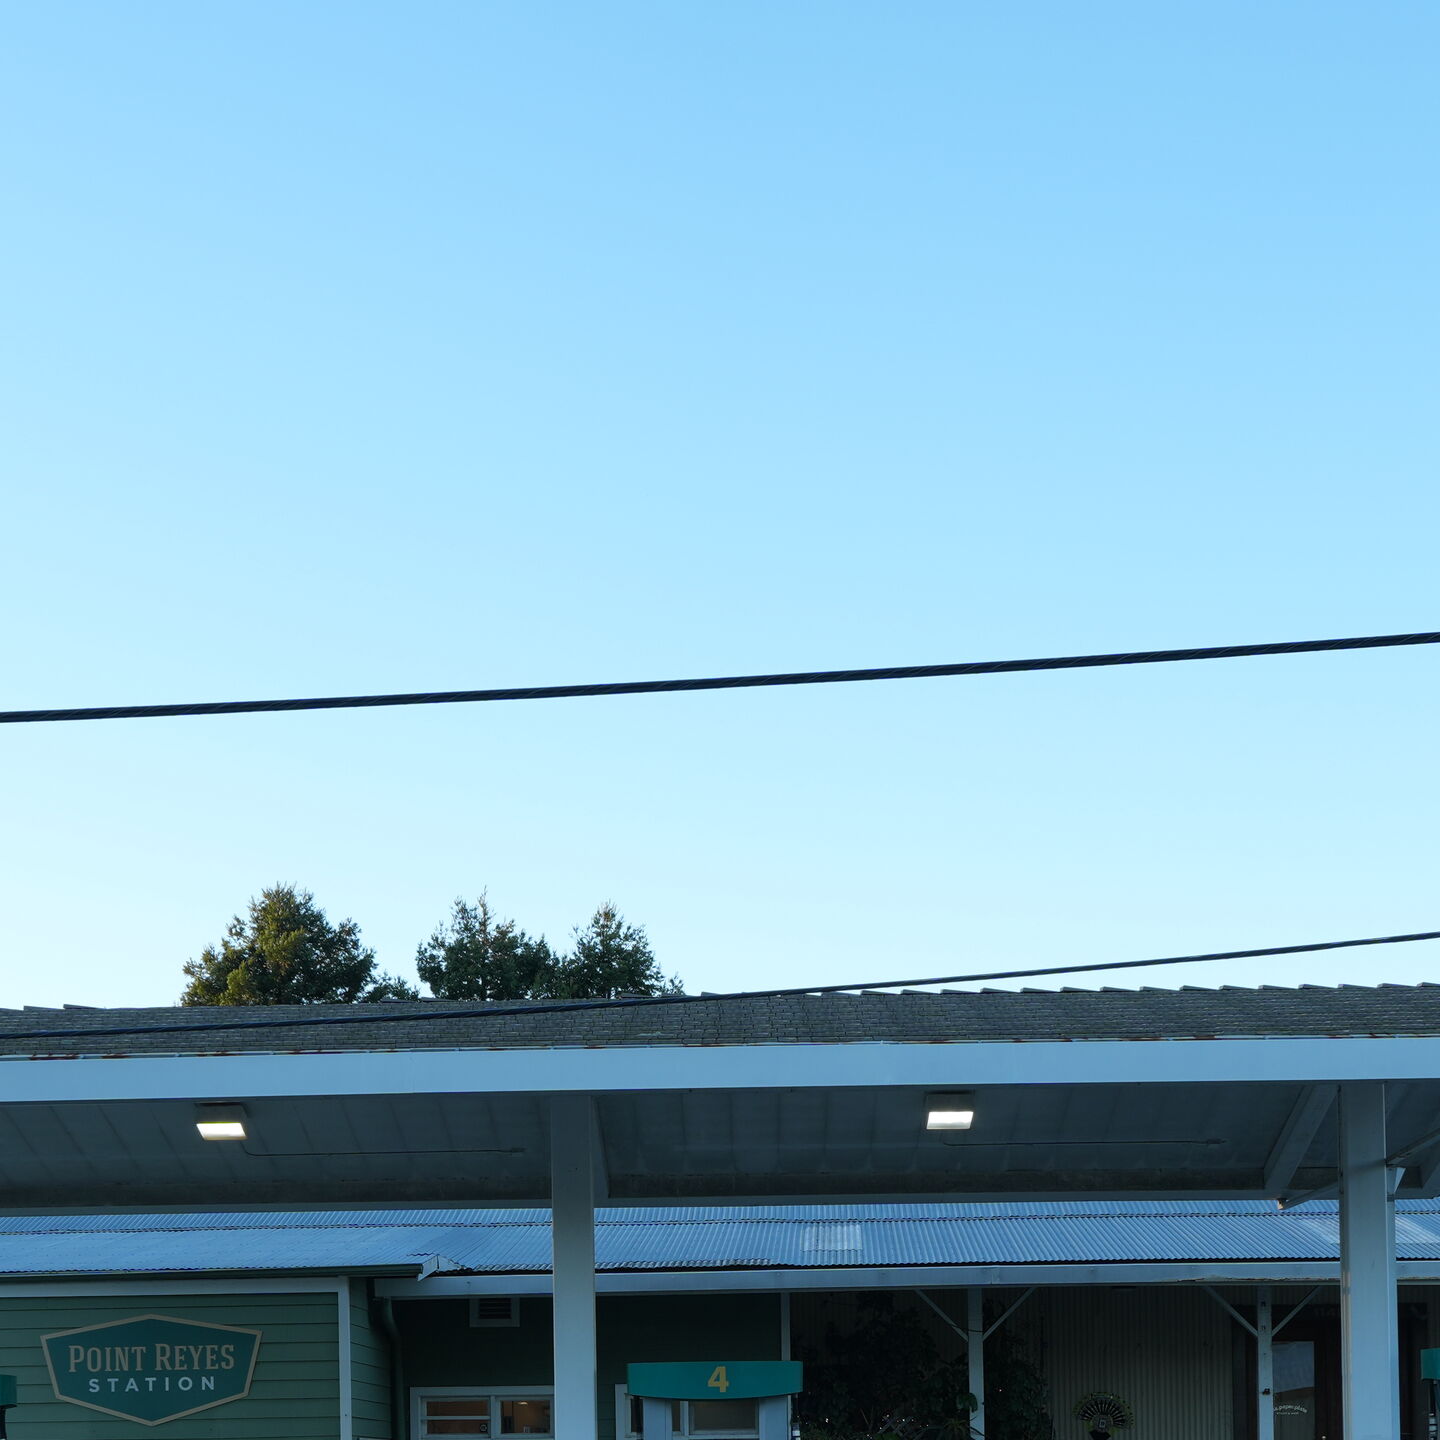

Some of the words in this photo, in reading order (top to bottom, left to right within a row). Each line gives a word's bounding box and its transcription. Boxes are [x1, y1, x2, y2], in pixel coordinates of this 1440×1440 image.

[68, 1345, 146, 1373] POINT
[155, 1343, 235, 1371] REYES
[88, 1376, 215, 1393] STATION
[707, 1366, 729, 1393] 4
